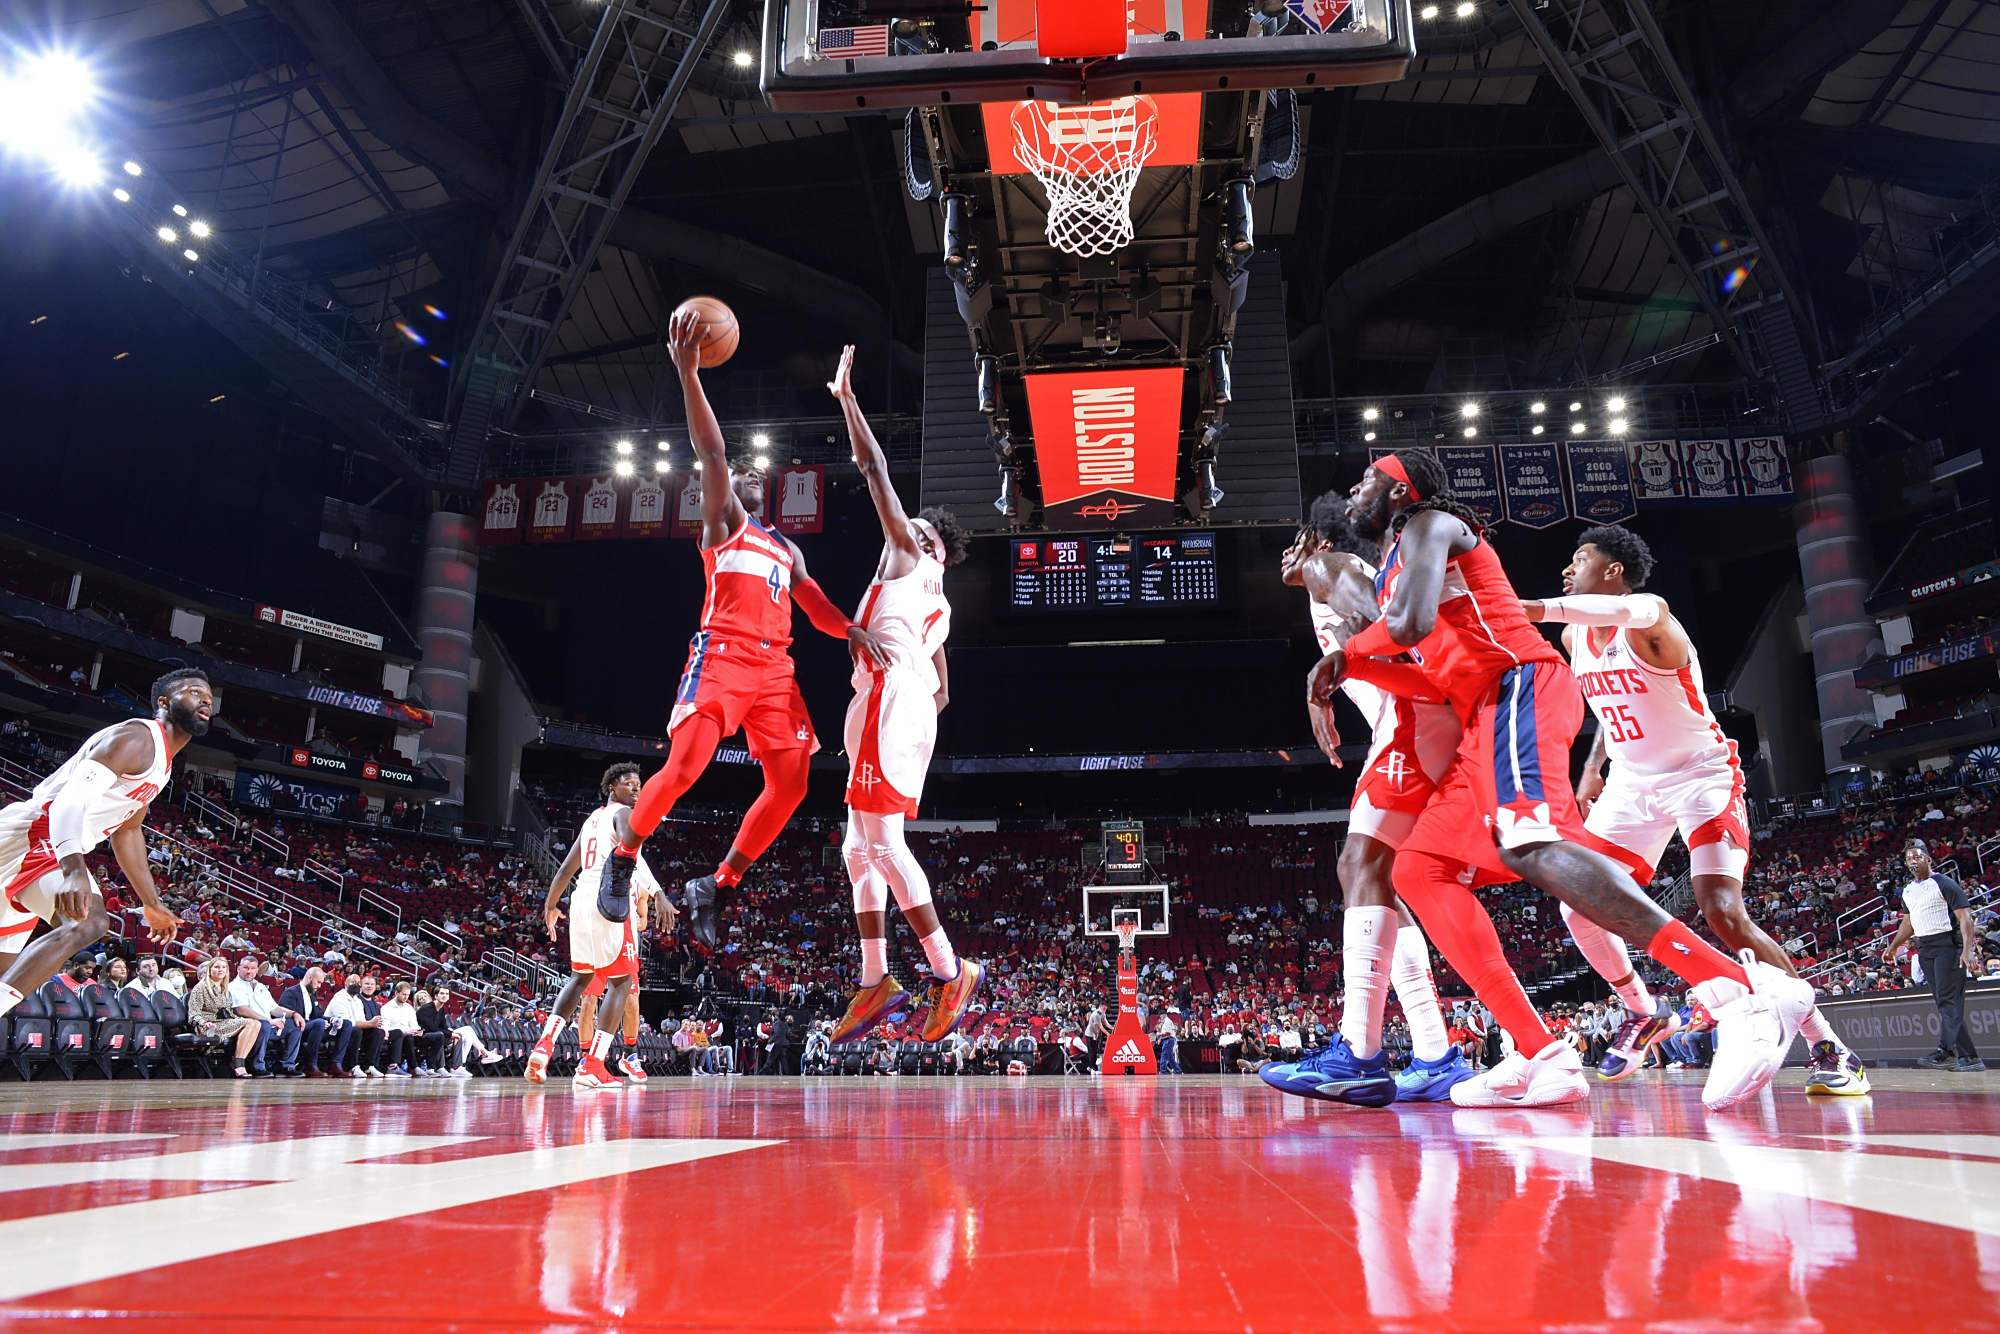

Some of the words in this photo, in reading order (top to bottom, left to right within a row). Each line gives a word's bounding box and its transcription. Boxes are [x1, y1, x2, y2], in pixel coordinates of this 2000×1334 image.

[1072, 387, 1135, 485] HOUSTON
[1456, 468, 1481, 476] 1998
[1520, 466, 1544, 475] 1999
[1586, 462, 1612, 471] 2000
[1454, 478, 1486, 487] WNBA
[1517, 476, 1549, 486] WNBA
[1584, 472, 1617, 481] WNBA
[797, 483, 804, 495] 11
[1508, 486, 1560, 496] Champions
[1576, 483, 1629, 493] Champions
[545, 500, 558, 512] 23
[593, 497, 608, 509] 24
[640, 495, 655, 507] 22
[496, 503, 510, 514] 45
[1058, 550, 1077, 562] 20
[1154, 547, 1172, 559] 14
[769, 564, 780, 600] 4
[1911, 577, 1957, 598] CLUTCH'S
[286, 613, 308, 623] ORDER
[315, 621, 332, 630] BEER
[333, 626, 351, 635] FROM
[351, 630, 368, 639] YOUR
[285, 620, 301, 628] SEAT
[302, 624, 320, 634] WITH
[334, 633, 363, 645] ROCKETS
[1893, 653, 1933, 677] LIGHT
[1941, 641, 1976, 665] FUSE
[307, 685, 345, 705] LIGHT
[350, 696, 381, 714] FUSE
[1601, 705, 1644, 742] 35
[716, 749, 748, 763] LIGHT
[311, 756, 346, 770] TOYOTA
[1080, 757, 1112, 770] LIGHT
[1118, 756, 1145, 769] FUSE
[380, 769, 413, 783] TOYOTA
[1116, 834, 1138, 843] 4:01
[585, 838, 597, 869] 8
[1125, 843, 1136, 861] 9
[1841, 1016, 1882, 1040] YOUR
[1886, 1013, 1921, 1037] KIDS
[1927, 1012, 1943, 1036] O
[1112, 1054, 1146, 1063] adidas
